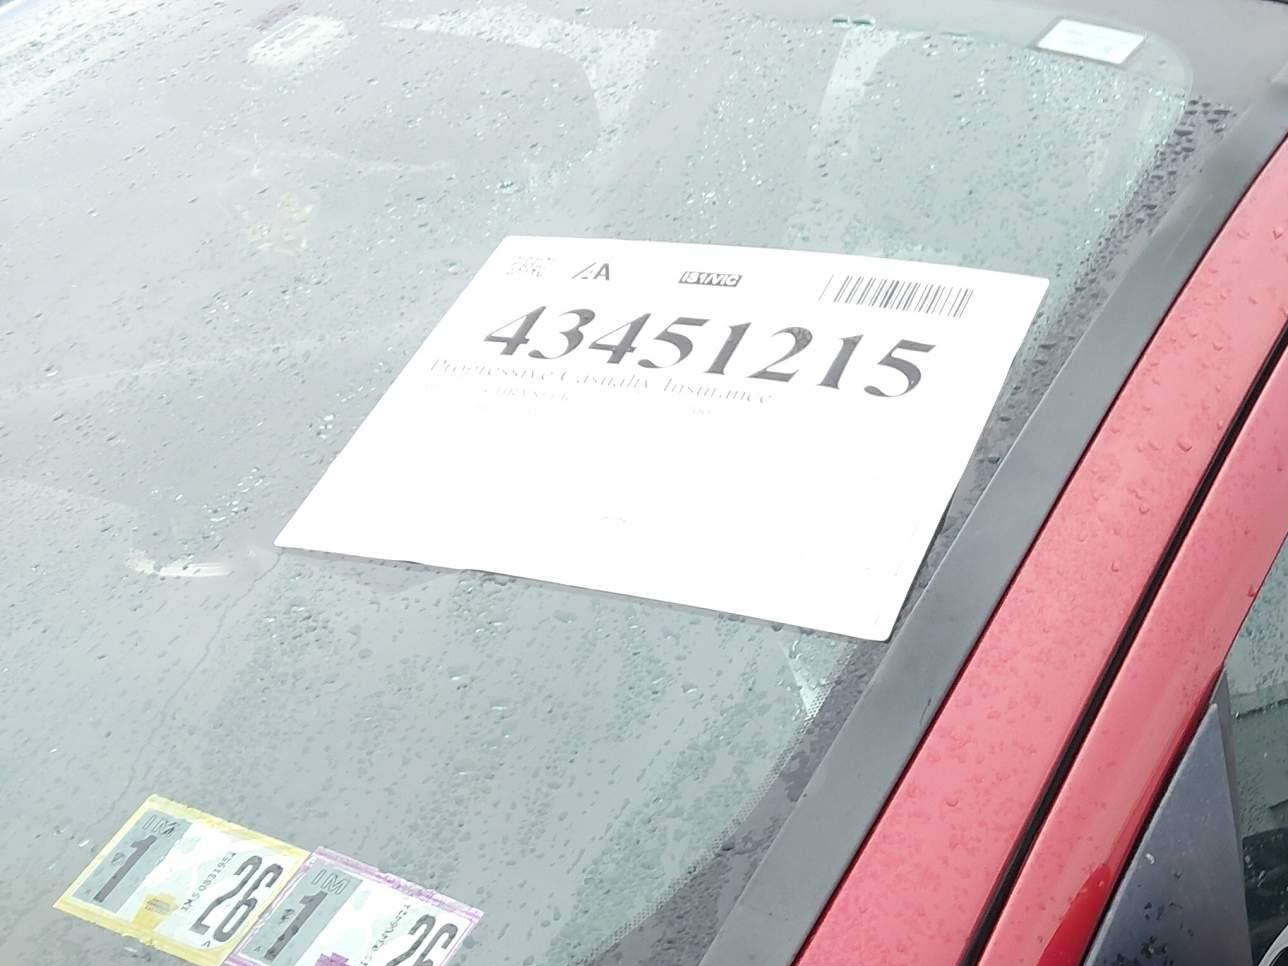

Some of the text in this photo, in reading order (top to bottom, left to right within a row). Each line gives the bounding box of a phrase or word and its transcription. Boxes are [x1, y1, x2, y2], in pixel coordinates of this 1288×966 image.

[482, 304, 937, 400] 43451215
[93, 834, 158, 903] 1
[190, 855, 284, 942] 26
[264, 890, 328, 962] 1
